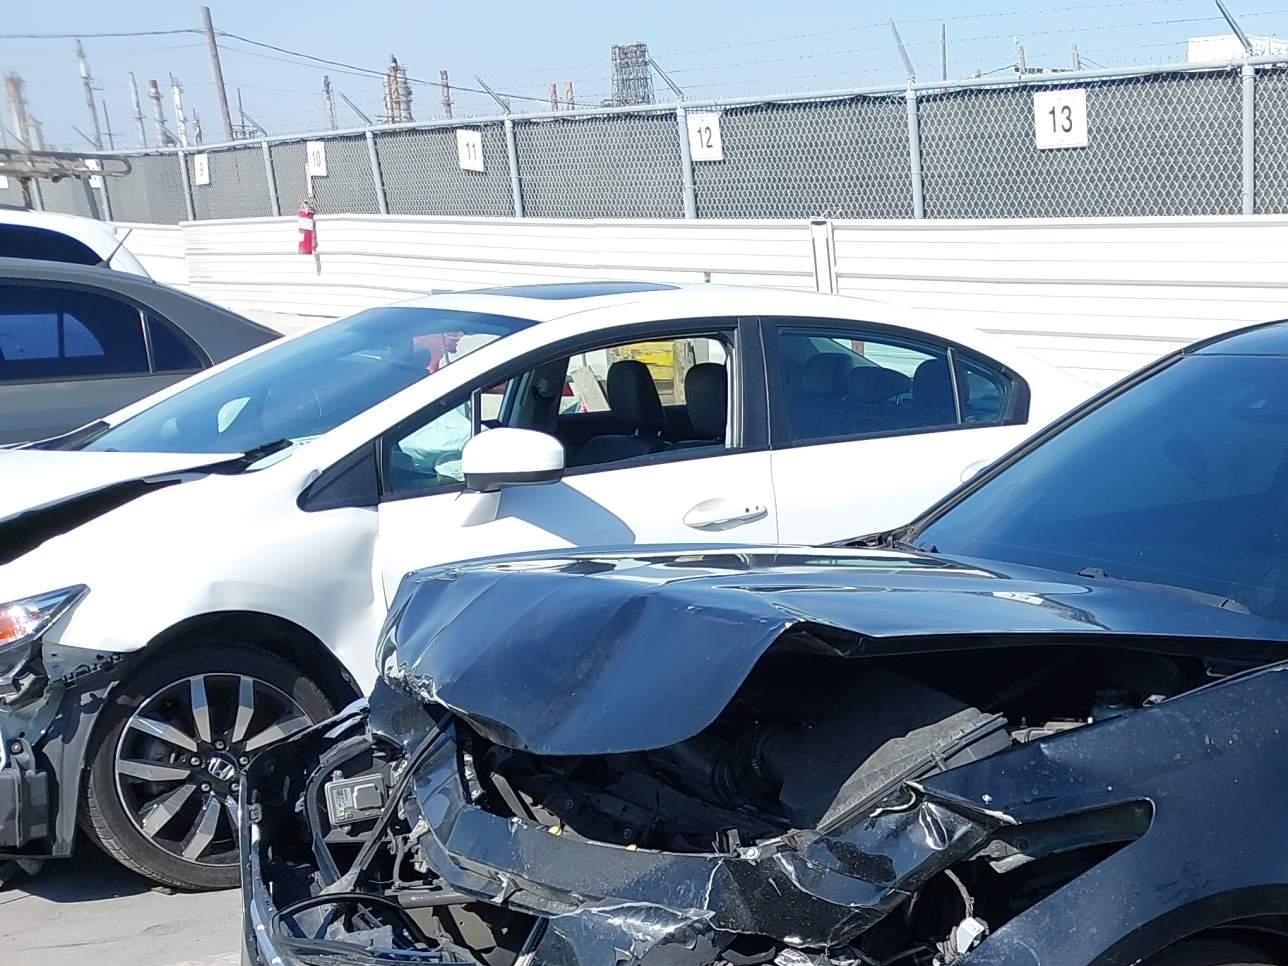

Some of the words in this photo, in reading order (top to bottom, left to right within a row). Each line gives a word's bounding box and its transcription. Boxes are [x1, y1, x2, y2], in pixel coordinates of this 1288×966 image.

[1049, 105, 1073, 133] 13
[697, 127, 713, 149] 12
[312, 149, 322, 167] 10
[466, 142, 478, 160] 11
